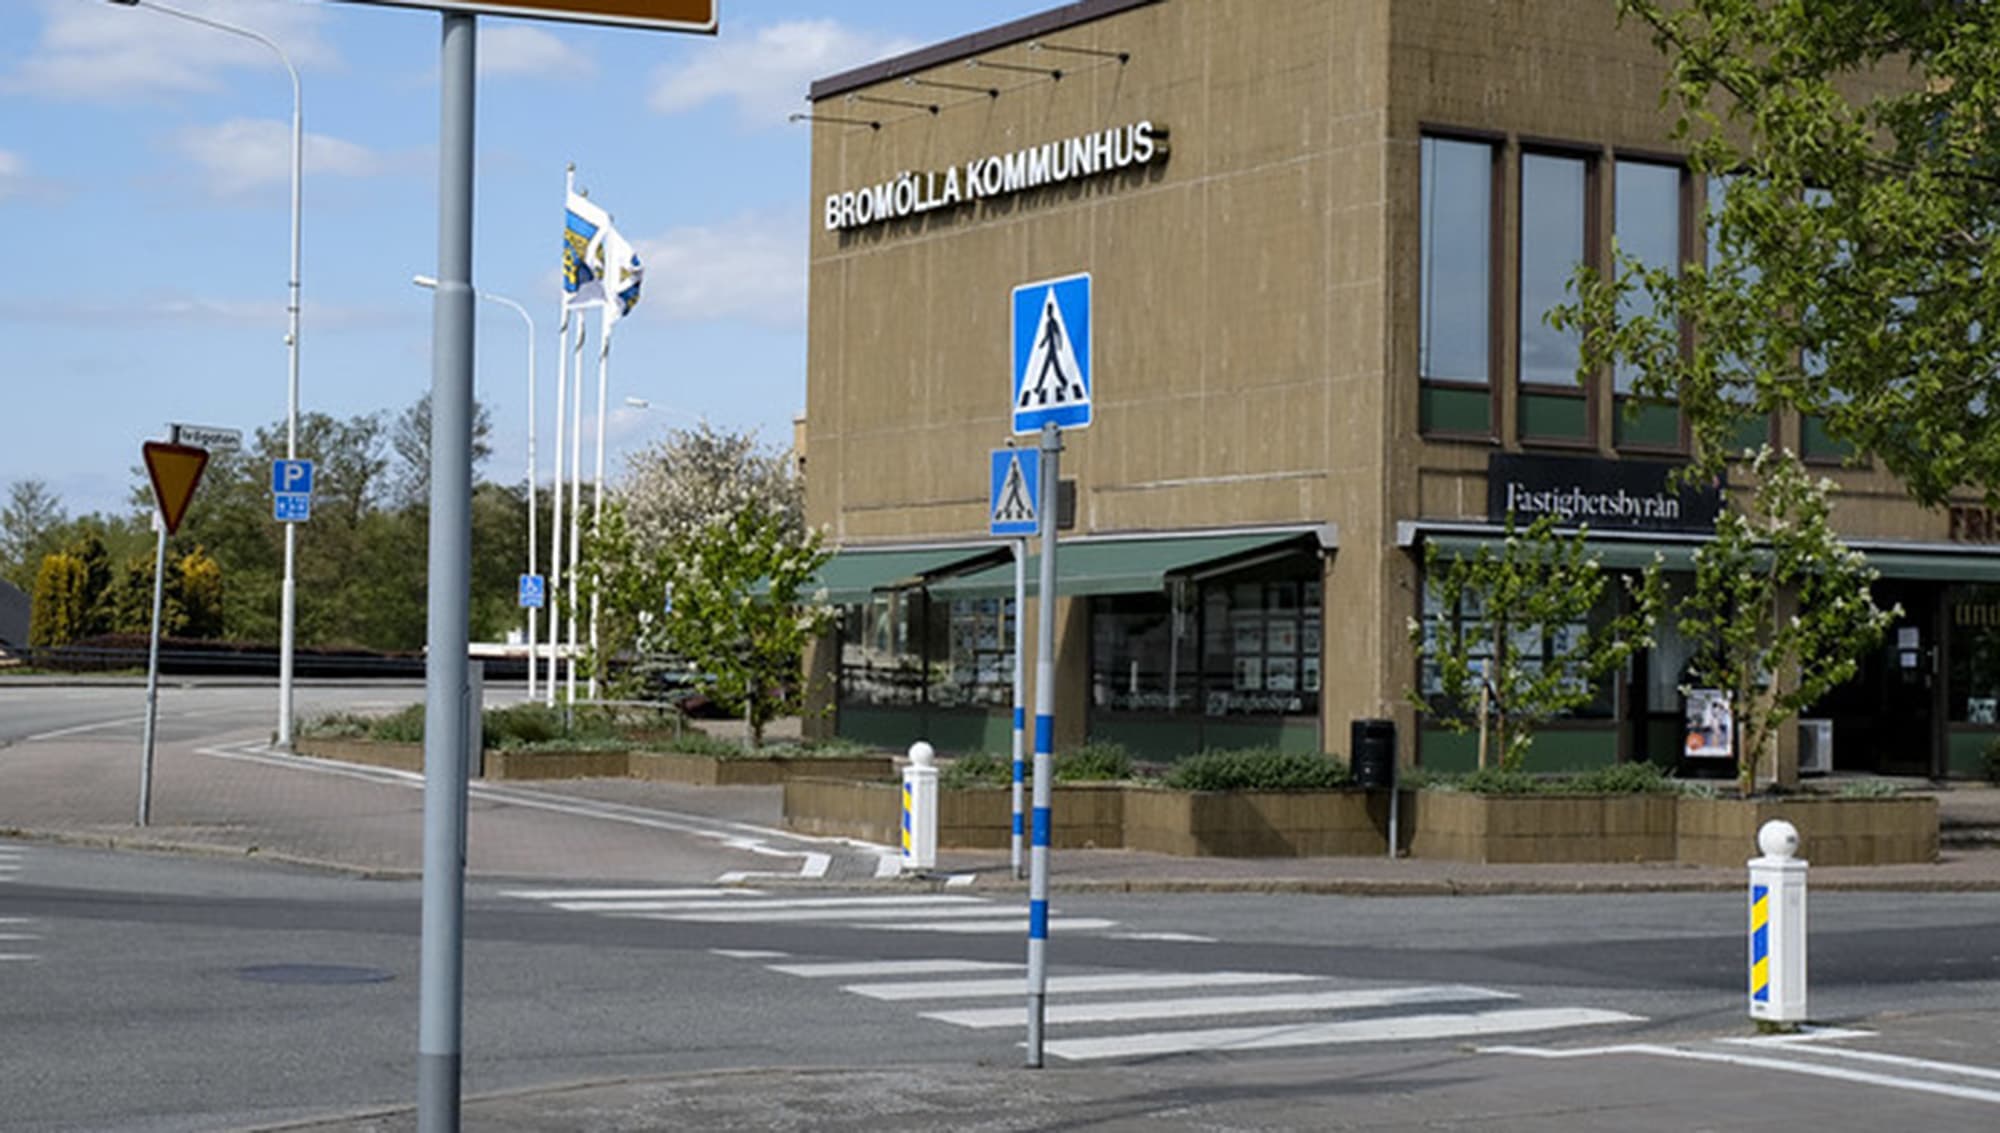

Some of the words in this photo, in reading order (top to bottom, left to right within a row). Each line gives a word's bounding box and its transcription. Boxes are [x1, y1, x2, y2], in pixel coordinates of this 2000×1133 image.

[825, 165, 961, 231] BROMÖLLA
[965, 119, 1155, 199] KOMMUNHUS
[284, 464, 304, 490] P
[1507, 482, 1679, 524] Fastighetsbyrån
